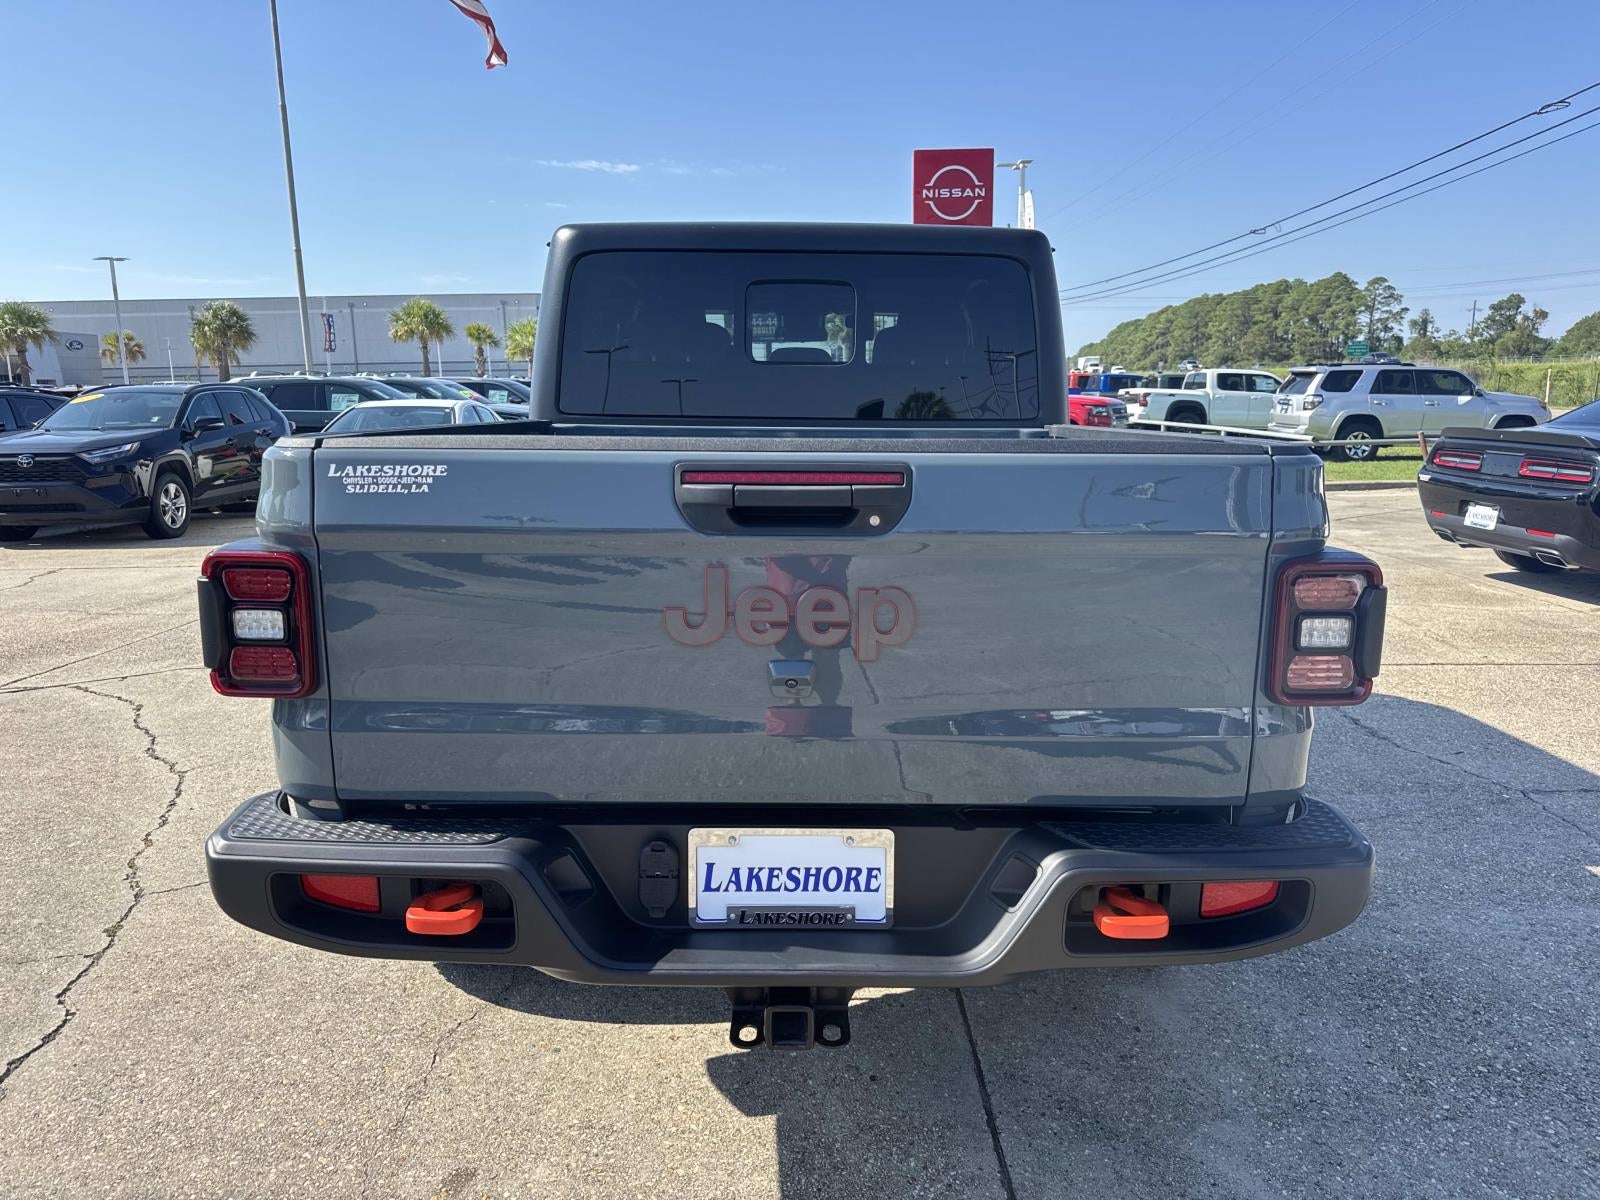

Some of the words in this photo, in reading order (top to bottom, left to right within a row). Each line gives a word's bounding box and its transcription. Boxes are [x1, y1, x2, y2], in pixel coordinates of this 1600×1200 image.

[923, 188, 985, 198] NISSAN
[328, 464, 448, 477] LAKESHORE
[346, 485, 408, 494] SLIDELL,
[411, 485, 429, 493] LA
[664, 565, 916, 663] Jeep
[702, 862, 881, 893] LAKESHORE
[739, 909, 845, 925] LAKESHORE
